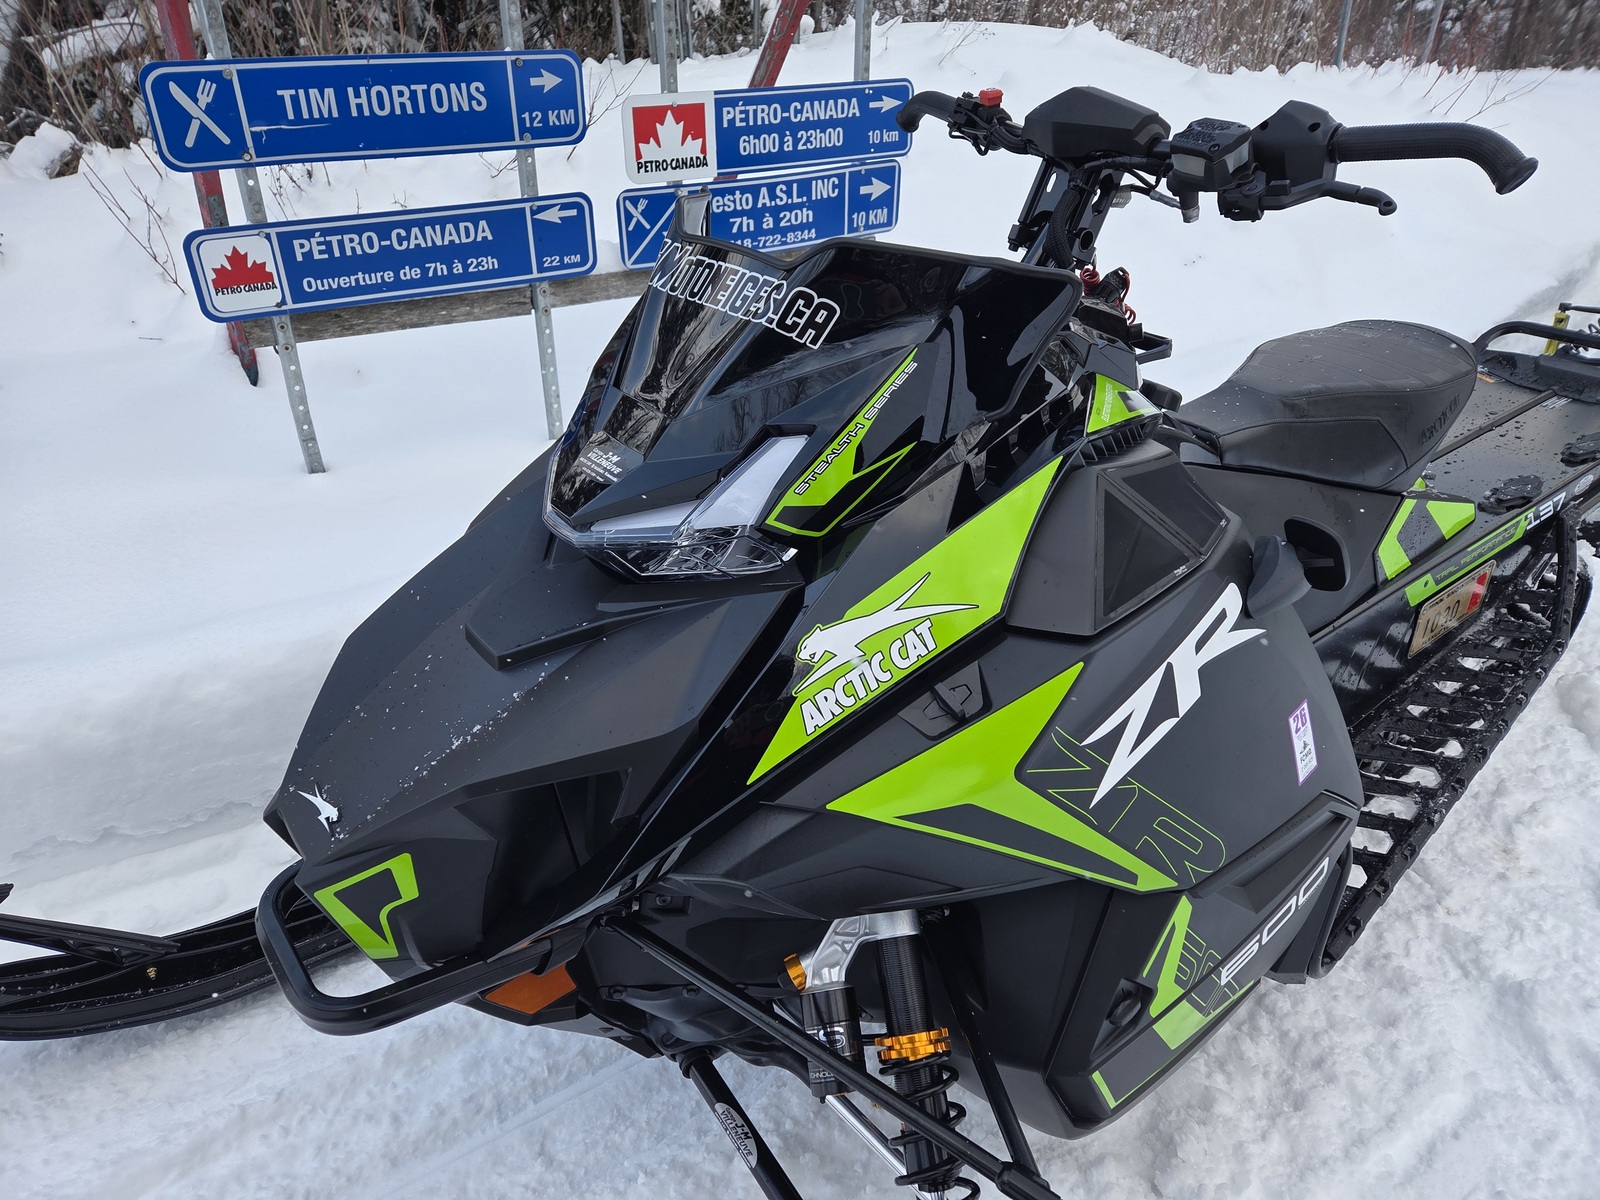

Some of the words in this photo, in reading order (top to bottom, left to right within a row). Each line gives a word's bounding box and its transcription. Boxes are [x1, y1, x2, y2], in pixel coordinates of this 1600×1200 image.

[277, 87, 339, 120] TIM
[347, 81, 488, 117] HORTONS
[521, 111, 543, 128] 12
[548, 109, 576, 126] KM
[722, 97, 860, 128] PÉTRO-CANADA
[739, 133, 779, 155] 6h00
[783, 131, 793, 151] à
[797, 127, 843, 150] 23h00
[868, 130, 880, 144] 10
[883, 128, 899, 143] km
[710, 189, 753, 214] esto
[757, 182, 807, 208] A.S.L.
[812, 177, 839, 200] INC
[729, 216, 755, 233] 7h
[762, 213, 774, 229] à
[779, 207, 814, 227] 20h
[852, 211, 867, 227] 10
[868, 208, 888, 225] KM
[292, 220, 494, 262] PÉTRO-CANADA
[302, 268, 395, 293] Ouverture
[399, 265, 422, 281] de
[425, 262, 448, 277] 7h
[452, 260, 463, 274] à
[467, 255, 499, 273] 23h
[543, 256, 561, 267] 22
[563, 254, 581, 265] KM
[793, 423, 865, 496] STEALTH
[863, 360, 918, 420] SERIES
[1526, 491, 1567, 531] 137
[1460, 526, 1517, 565] PERFORMANCE
[800, 651, 893, 737] ARCTIC
[889, 617, 938, 670] CAT
[1079, 582, 1267, 810] ZR
[1292, 706, 1308, 735] 26
[1220, 856, 1330, 986] 600
[720, 1109, 754, 1158] VILLENEUVE
